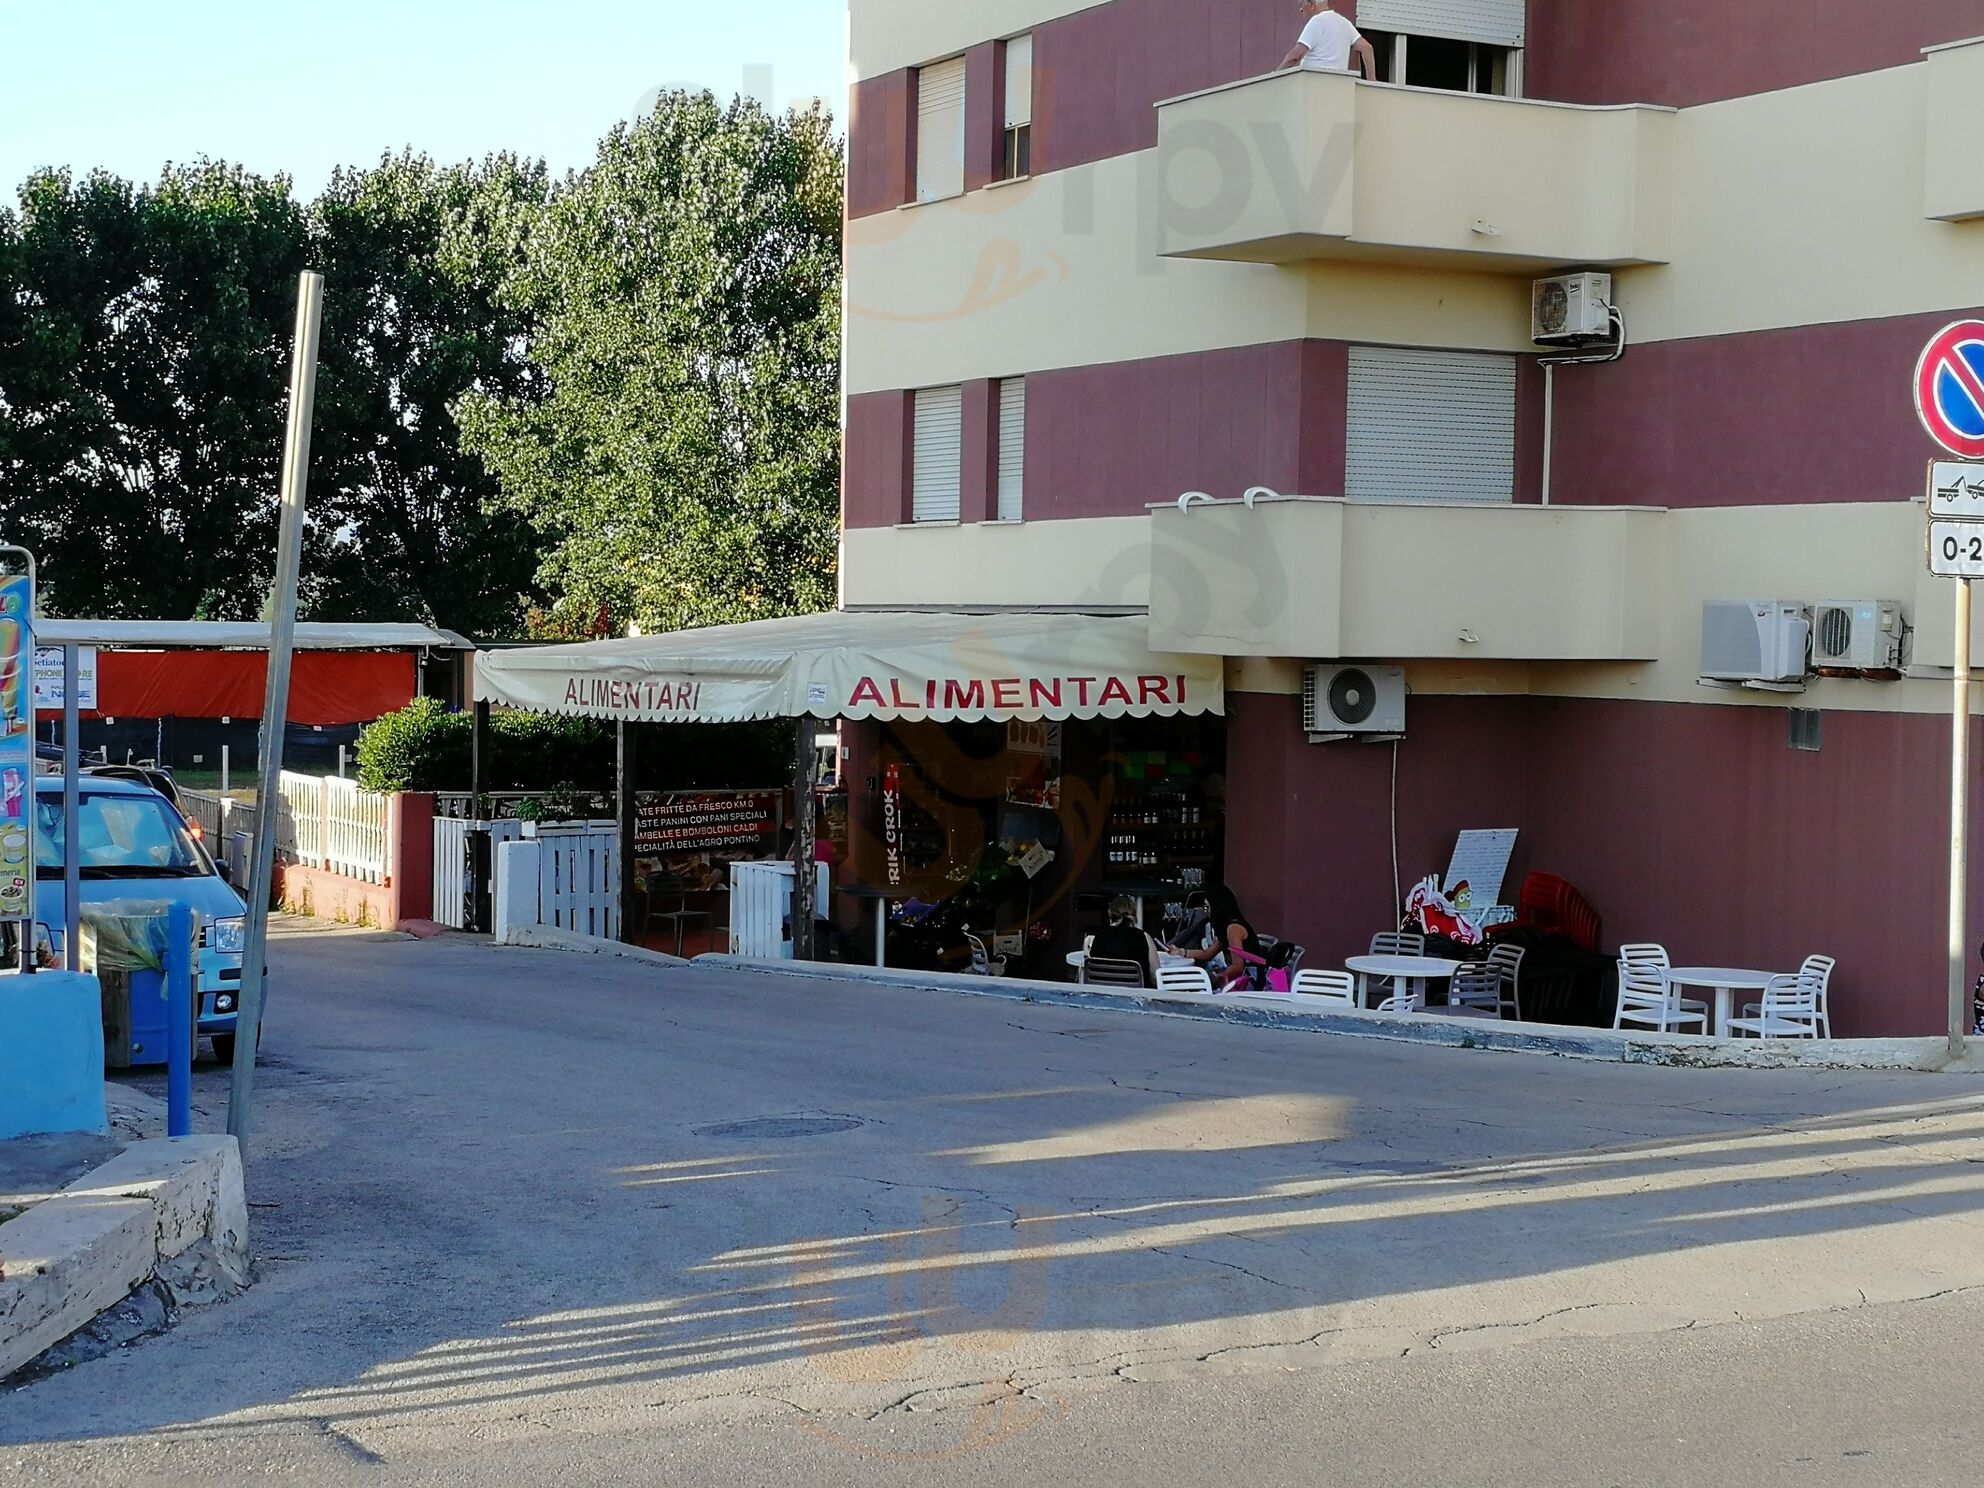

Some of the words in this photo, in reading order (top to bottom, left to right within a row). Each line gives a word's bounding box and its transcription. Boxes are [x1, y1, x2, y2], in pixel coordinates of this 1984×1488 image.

[564, 677, 701, 711] ALIMENTARI
[848, 674, 1187, 709] ALIMENTARI
[655, 804, 685, 816] FRITTE
[685, 802, 698, 813] DA
[699, 801, 733, 812] FRESCO
[734, 799, 747, 809] KM
[884, 789, 896, 843] CROK
[660, 817, 689, 827] PANINI
[690, 815, 709, 824] CON
[710, 813, 729, 823] PANI
[730, 810, 767, 821] SPECIALI
[675, 828, 681, 837] E
[682, 824, 732, 837] BOMBOLONI
[733, 823, 758, 832] CALDI
[676, 836, 723, 849] DELL'AGRO
[724, 834, 760, 845] PONTINO
